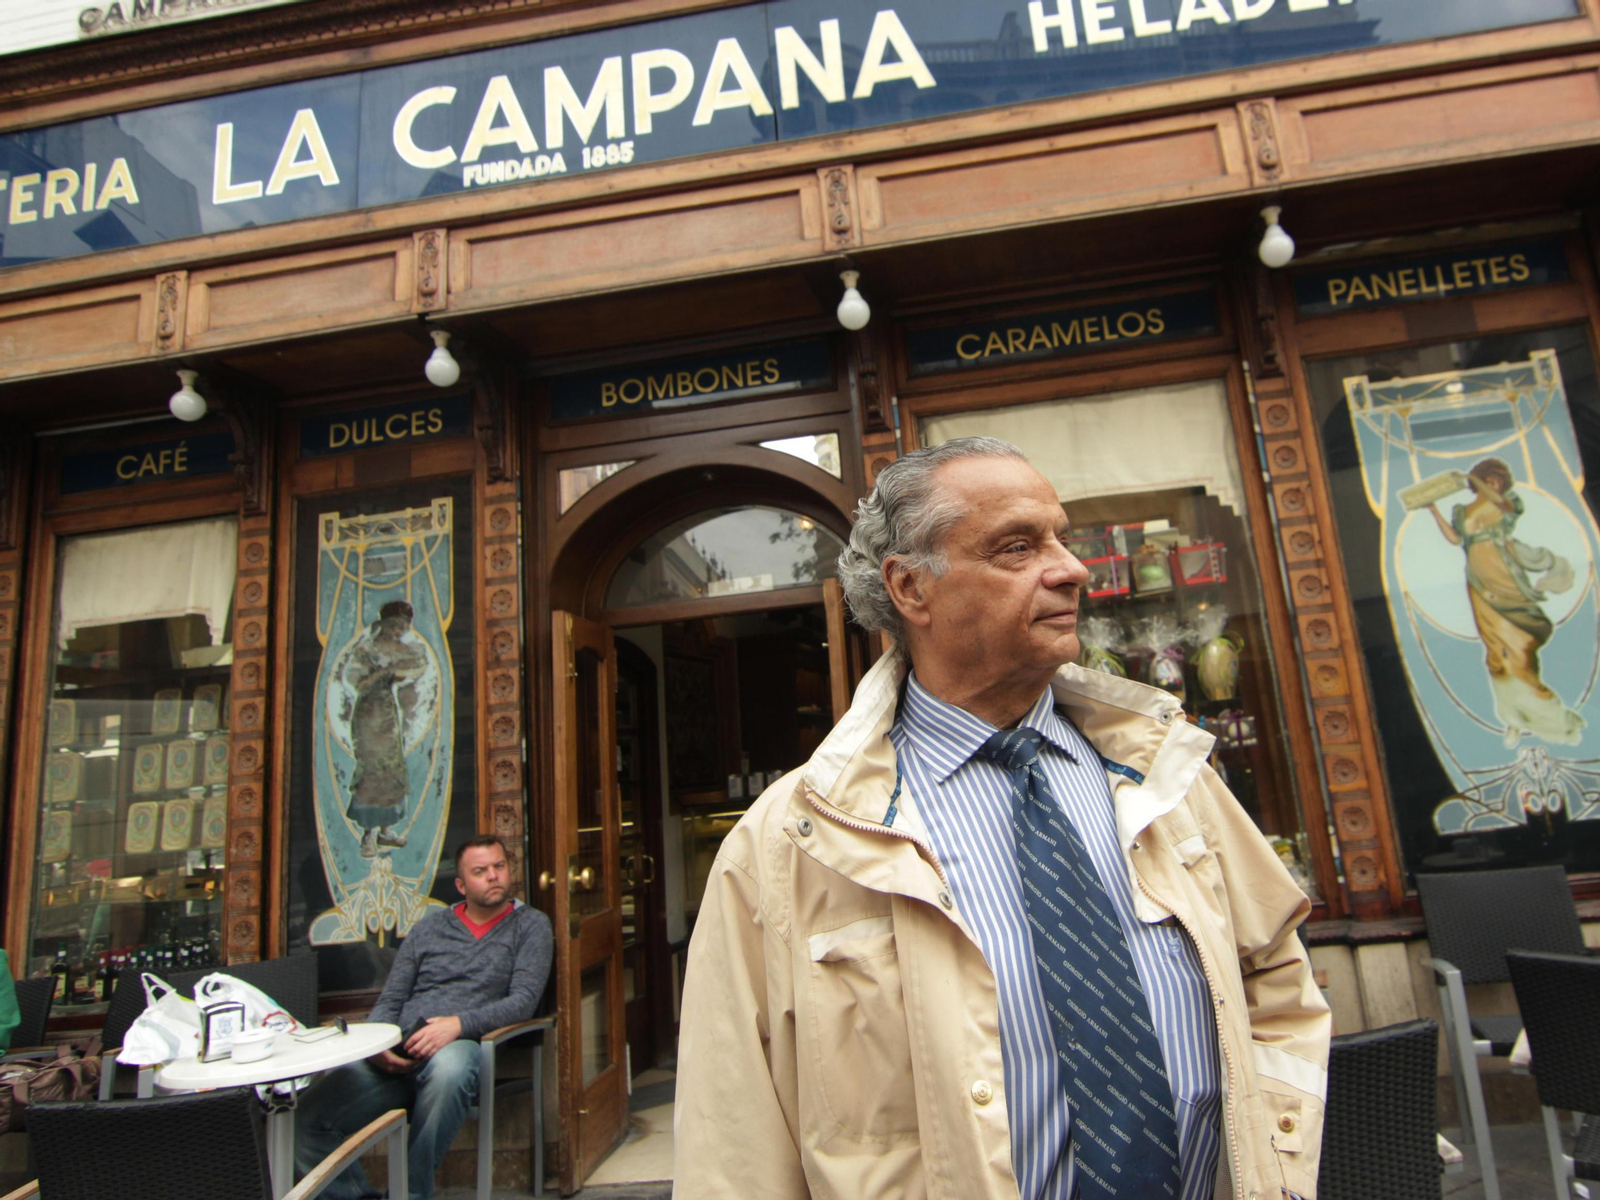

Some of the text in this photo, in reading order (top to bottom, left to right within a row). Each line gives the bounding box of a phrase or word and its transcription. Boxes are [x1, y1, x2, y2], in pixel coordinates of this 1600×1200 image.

[212, 108, 340, 205] LA
[392, 9, 937, 170] CAMPANA
[462, 138, 635, 188] FUNDADA 1885
[1327, 253, 1531, 306] PANELLETES
[955, 307, 1166, 360] CARAMELOS
[600, 357, 780, 408] BOMBONES
[328, 407, 444, 449] DULCES
[115, 440, 189, 480] CAFÉ
[1049, 970, 1072, 993] ARMANI
[1131, 1012, 1152, 1033] GIORGIO
[1090, 1056, 1113, 1079] ARMANI
[1135, 1050, 1157, 1071] GIORGIO
[1109, 1123, 1132, 1144] GIORGIO
